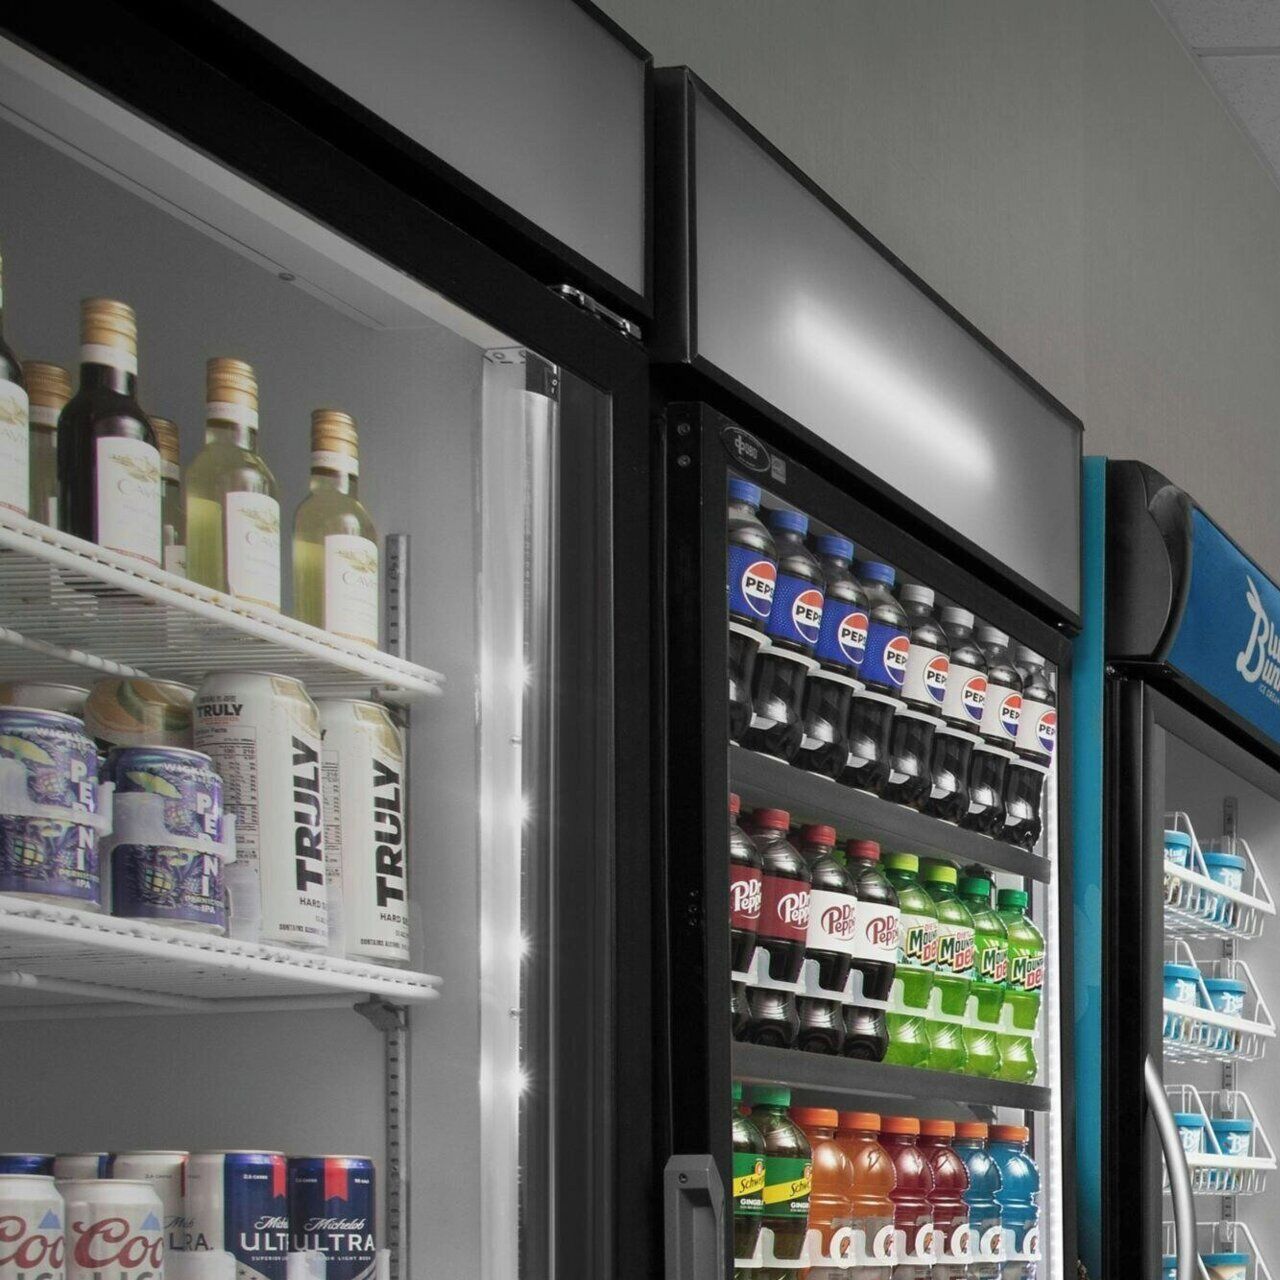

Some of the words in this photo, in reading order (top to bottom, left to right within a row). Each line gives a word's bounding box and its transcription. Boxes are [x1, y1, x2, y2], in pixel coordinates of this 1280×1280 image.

[292, 735, 325, 892] TRULY
[372, 758, 405, 908] TRULY
[293, 1234, 375, 1251] ULTRA
[304, 1217, 365, 1231] Michelob
